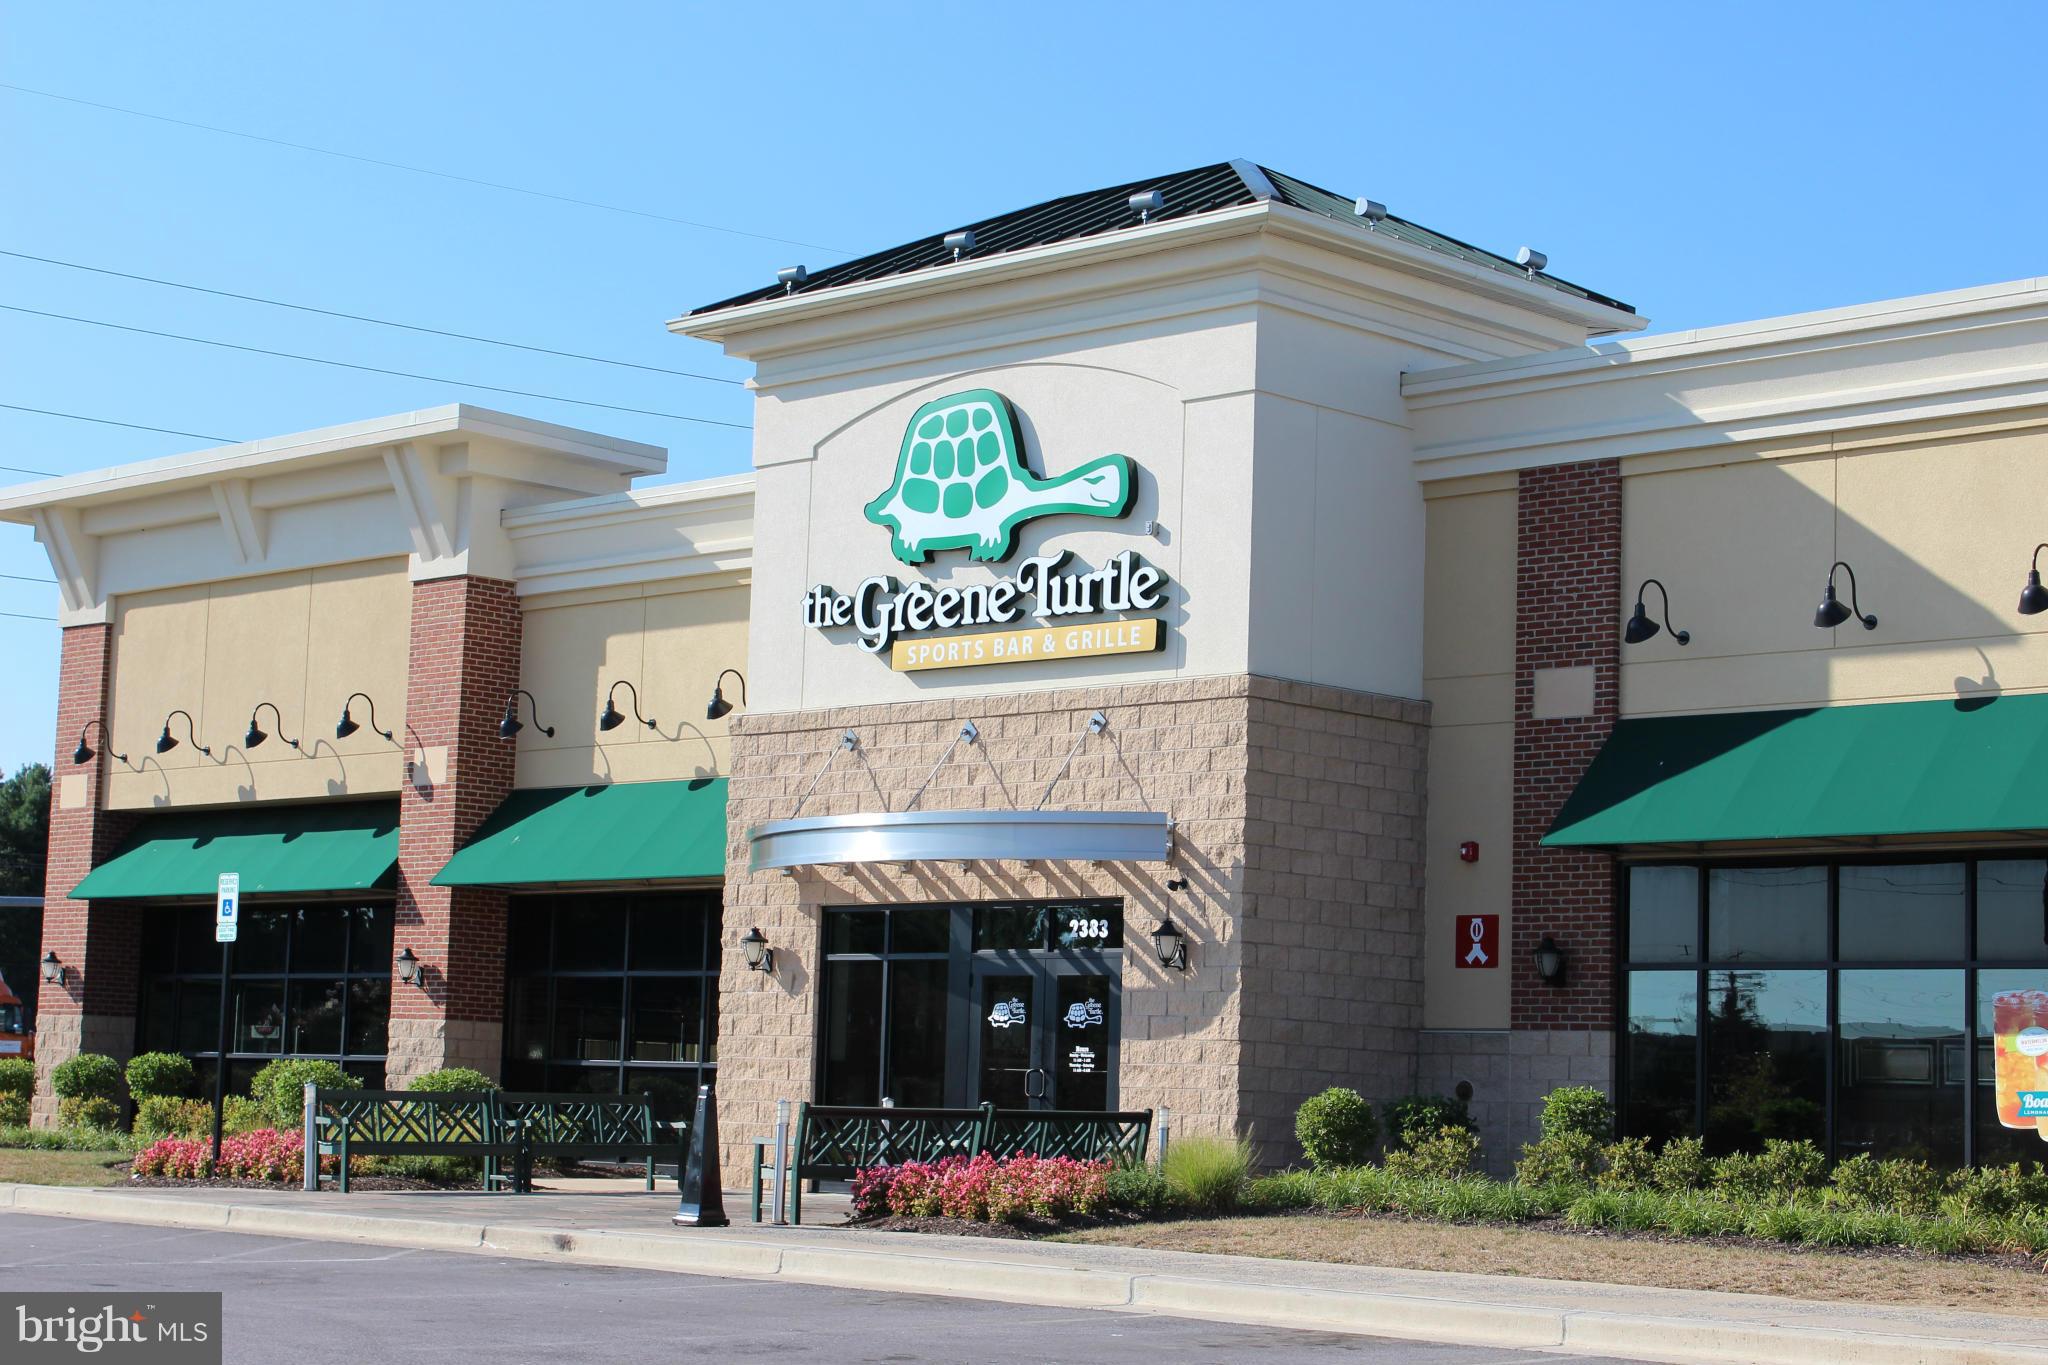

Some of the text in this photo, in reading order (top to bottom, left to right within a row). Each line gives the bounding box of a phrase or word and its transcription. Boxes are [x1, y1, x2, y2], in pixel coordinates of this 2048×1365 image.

[801, 550, 1161, 653] the Greene Turtle
[907, 626, 1142, 665] SPORTS BAR & GRILLE
[1069, 919, 1109, 939] 2383
